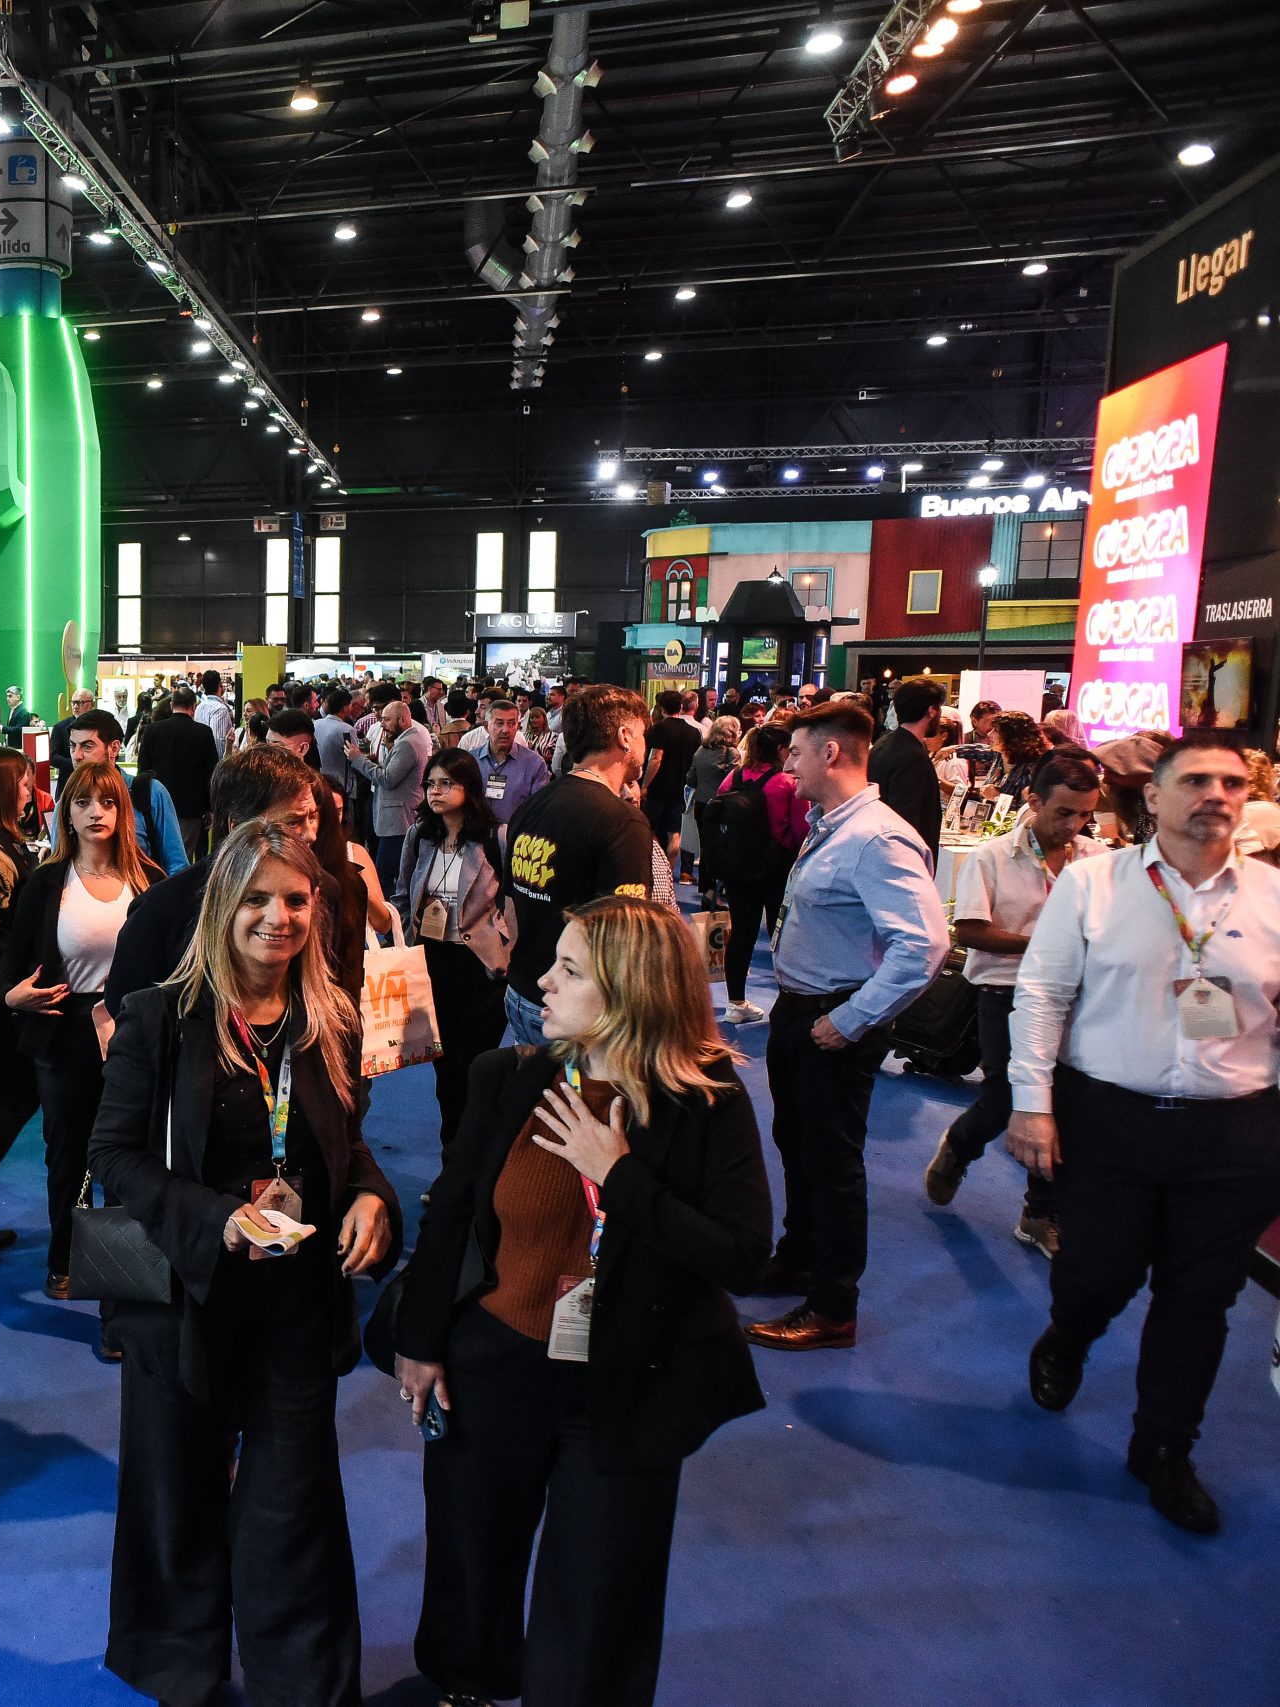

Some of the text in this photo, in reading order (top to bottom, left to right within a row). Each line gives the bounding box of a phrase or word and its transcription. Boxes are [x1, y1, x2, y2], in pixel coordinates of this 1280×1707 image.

[1177, 230, 1254, 304] Llegar
[921, 494, 1030, 518] Buenos
[1038, 486, 1092, 513] Air
[1205, 597, 1273, 623] TRASLASIERRA
